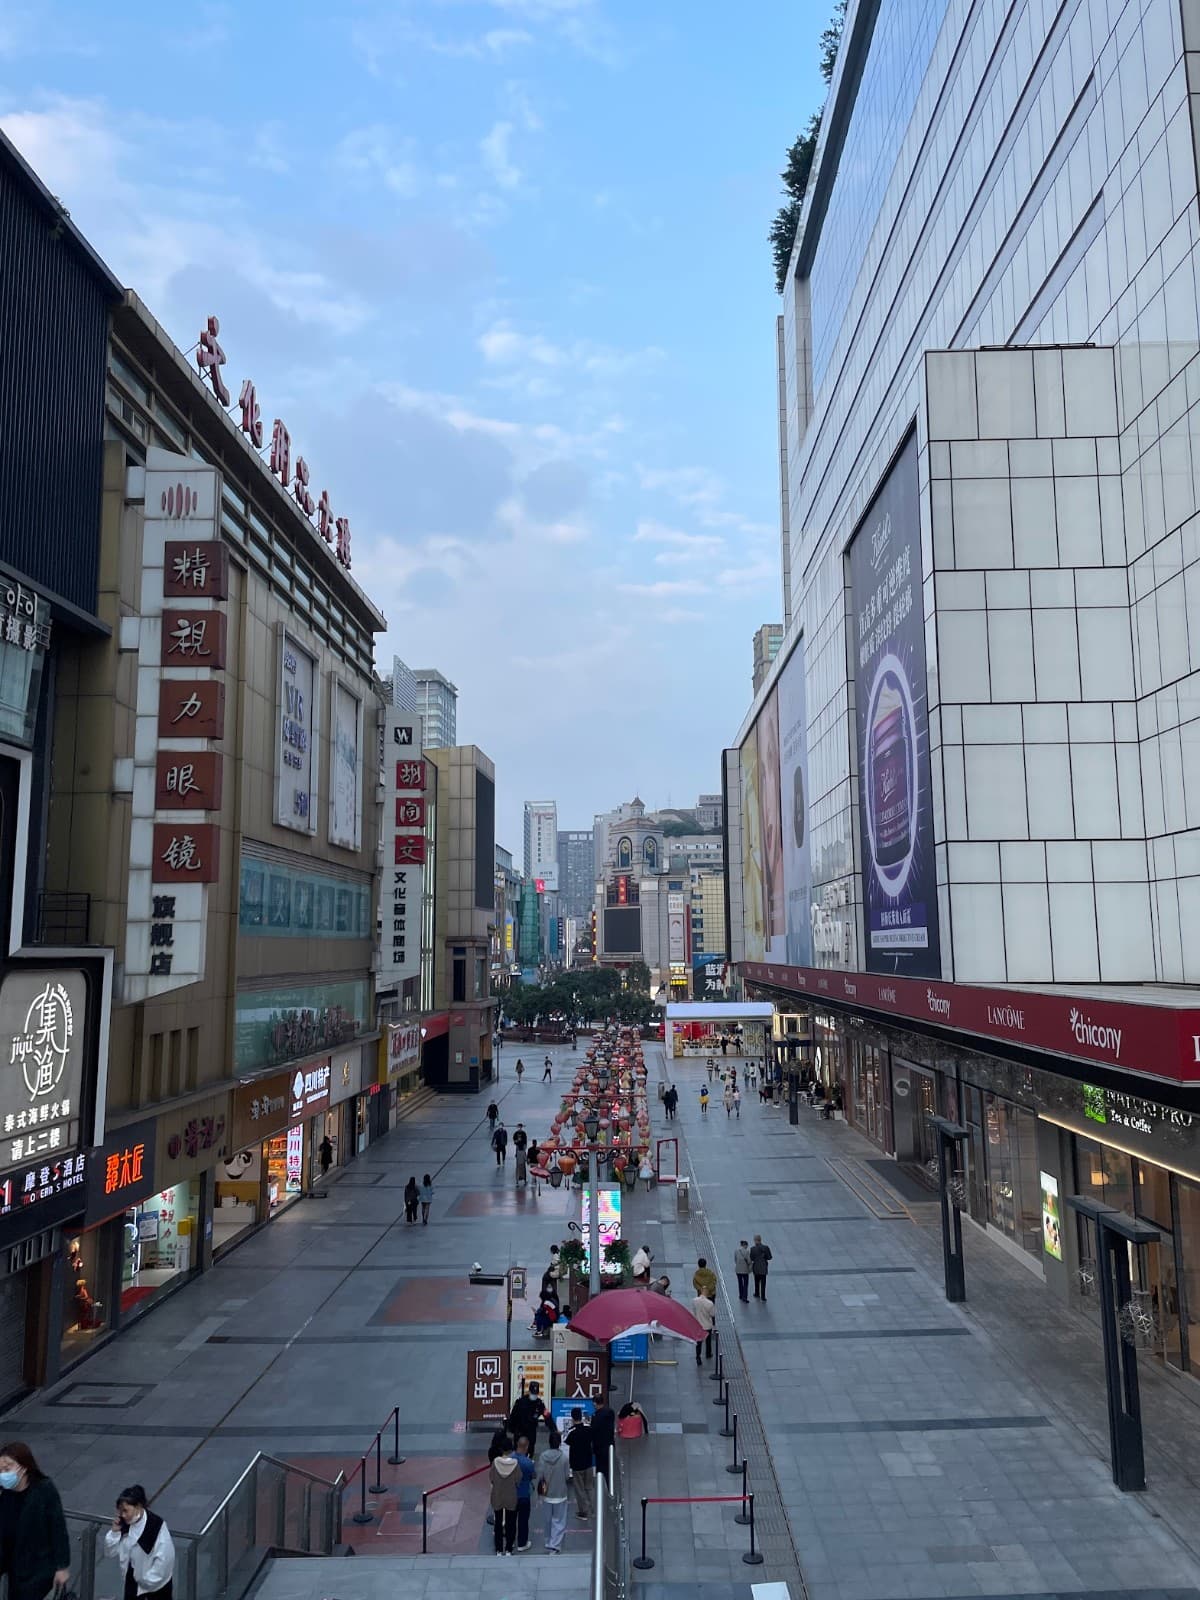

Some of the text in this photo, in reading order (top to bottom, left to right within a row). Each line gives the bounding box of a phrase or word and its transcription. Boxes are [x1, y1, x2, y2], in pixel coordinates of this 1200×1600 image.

[150, 895, 176, 976] 旗舰店
[929, 991, 950, 1019] chicony
[987, 1004, 1025, 1030] LANCÔME
[1075, 1013, 1121, 1058] chicony
[304, 1066, 331, 1093] 四川特产
[4, 1099, 71, 1132] 泰式海鲜火锅
[11, 1127, 61, 1161] 请上二楼
[62, 1173, 84, 1190] HOTEL
[474, 1382, 504, 1399] 出口
[571, 1382, 602, 1398] 入口
